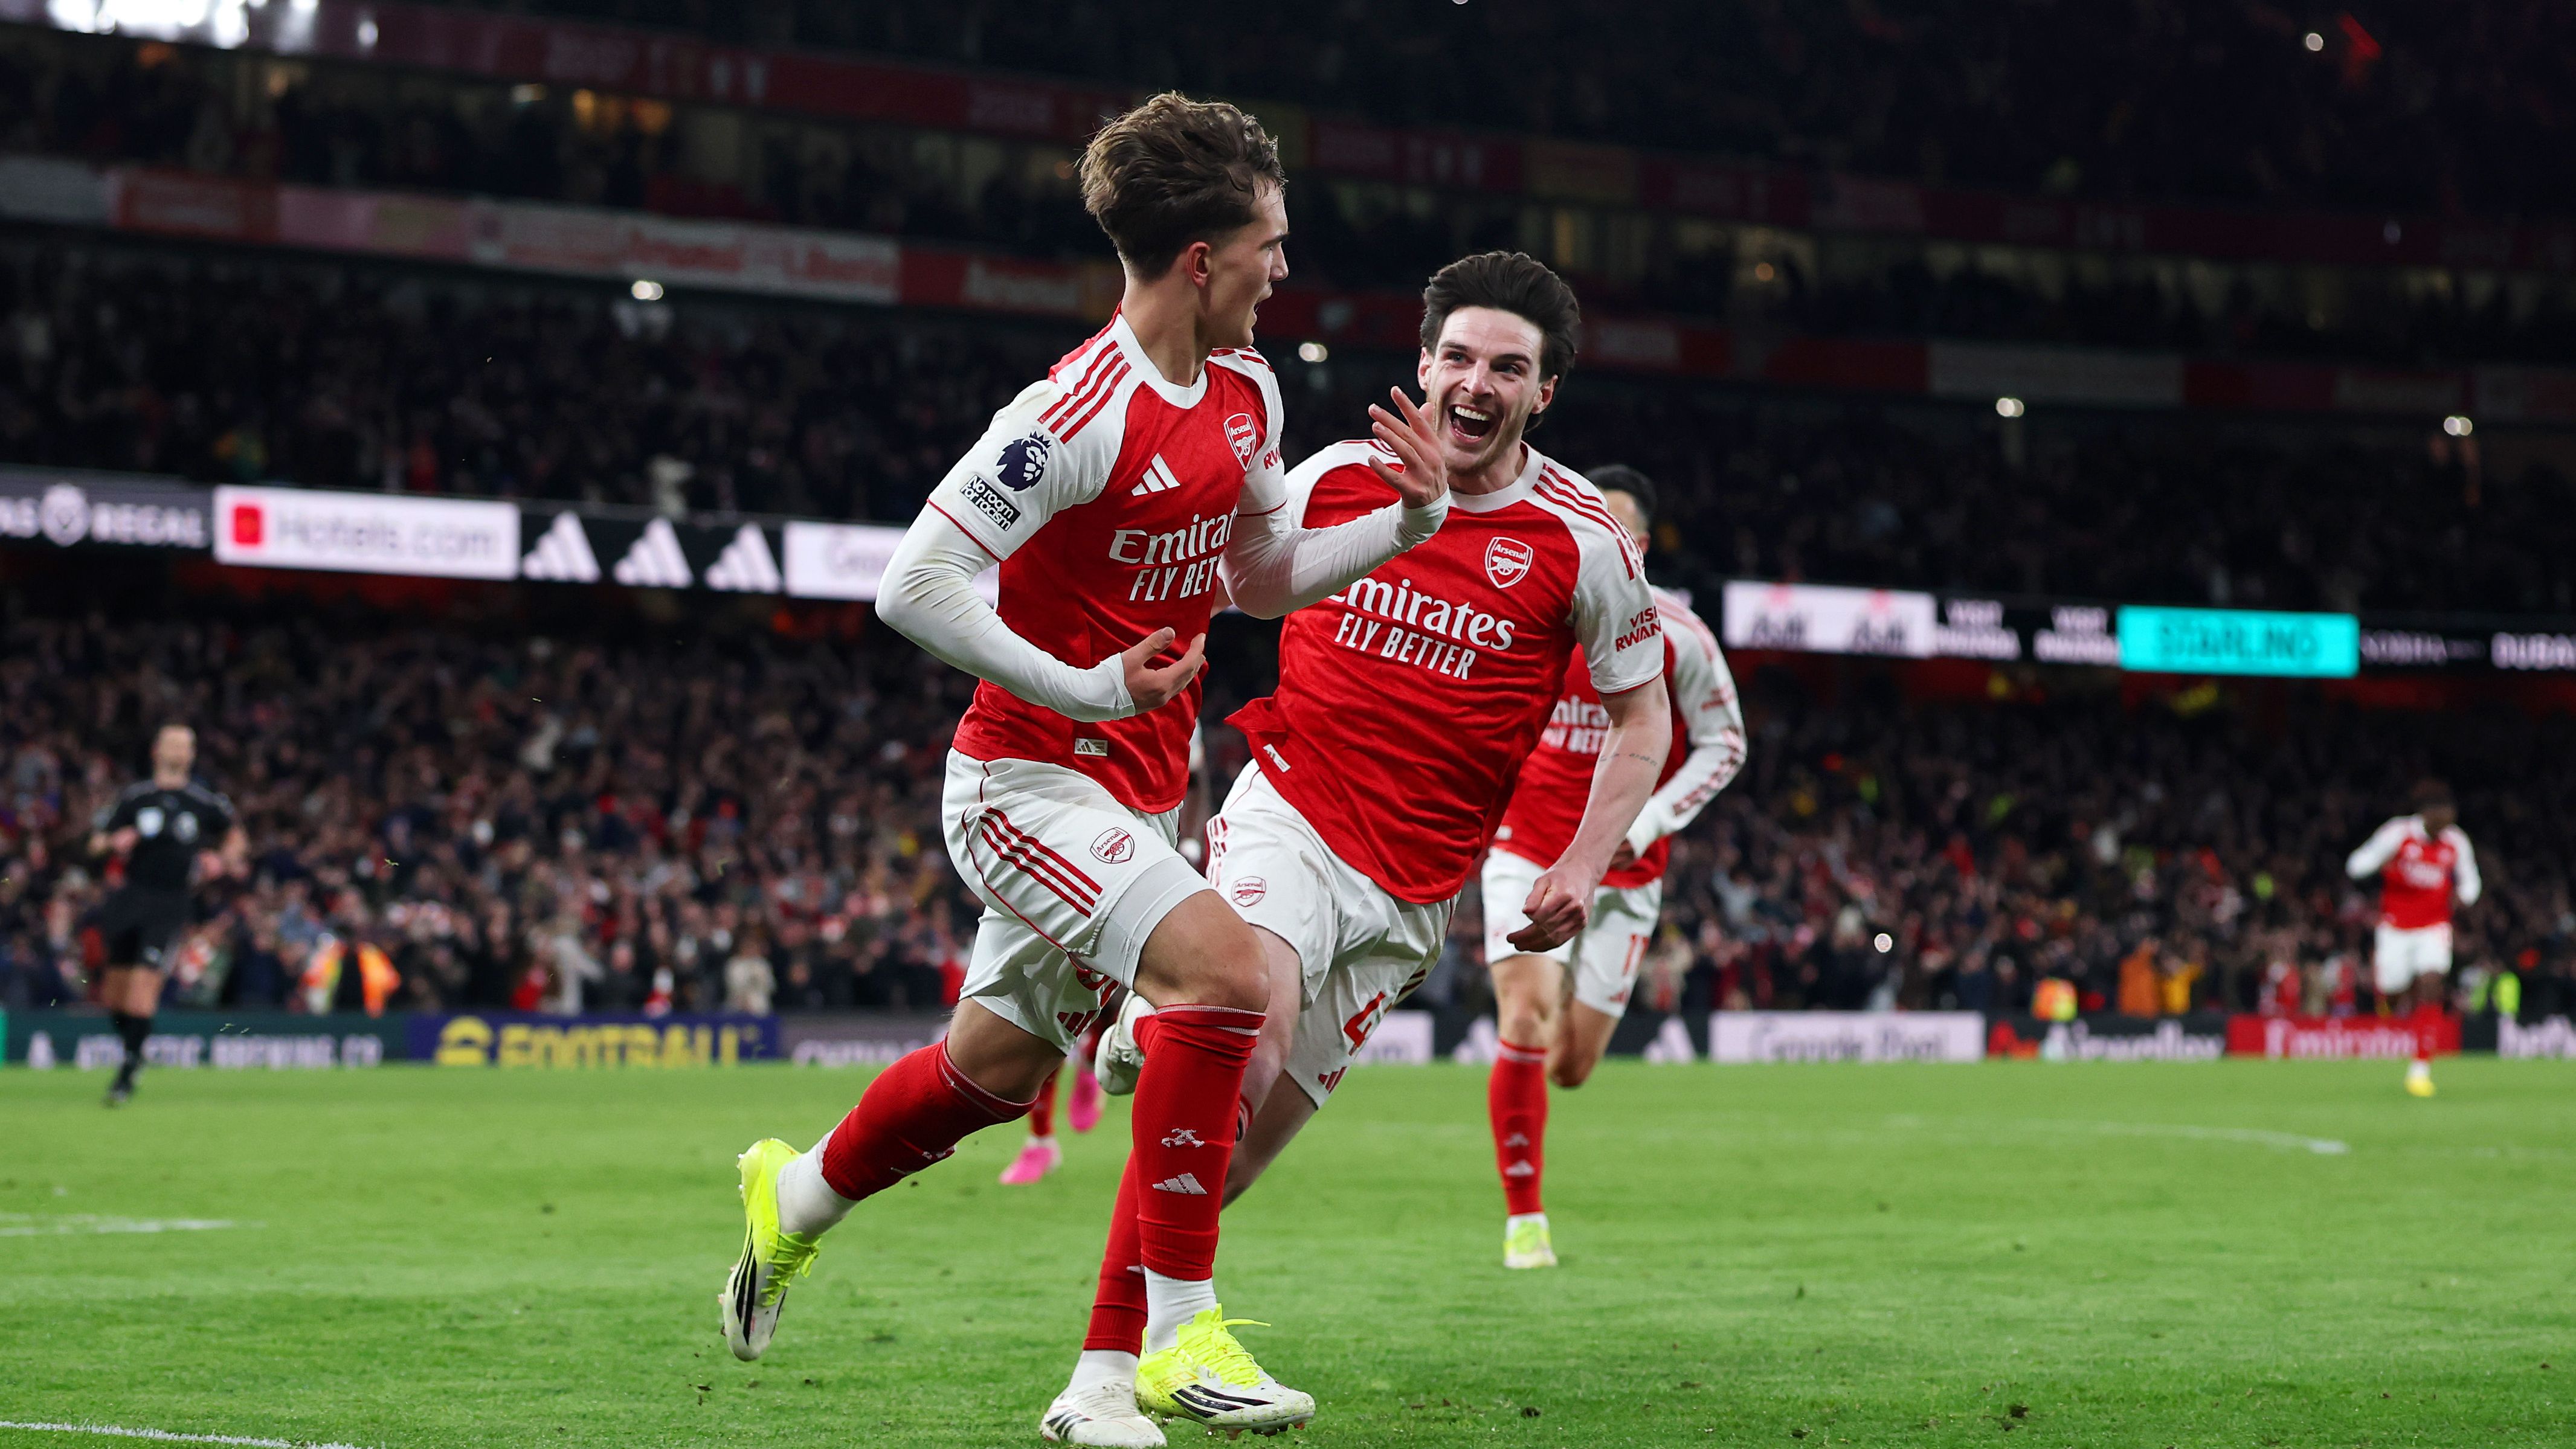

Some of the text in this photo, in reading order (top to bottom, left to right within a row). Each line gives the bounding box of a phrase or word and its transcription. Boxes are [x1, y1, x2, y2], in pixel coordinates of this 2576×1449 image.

[1230, 422, 1251, 435] Arsenal
[961, 483, 1011, 530] for racism
[968, 475, 1014, 519] No room
[1109, 505, 1238, 565] Emirat
[1493, 543, 1527, 561] Arsenal
[1129, 554, 1220, 602] FLY BET
[1615, 619, 1662, 652] RWAN
[1630, 606, 1658, 628] VISI
[1334, 612, 1476, 681] FLY BETTER
[1096, 831, 1122, 853] Arsenal
[1236, 881, 1262, 890] Arsenal
[1622, 934, 1651, 976] 11
[1343, 991, 1393, 1056] 4
[2265, 1018, 2416, 1061] Emirate
